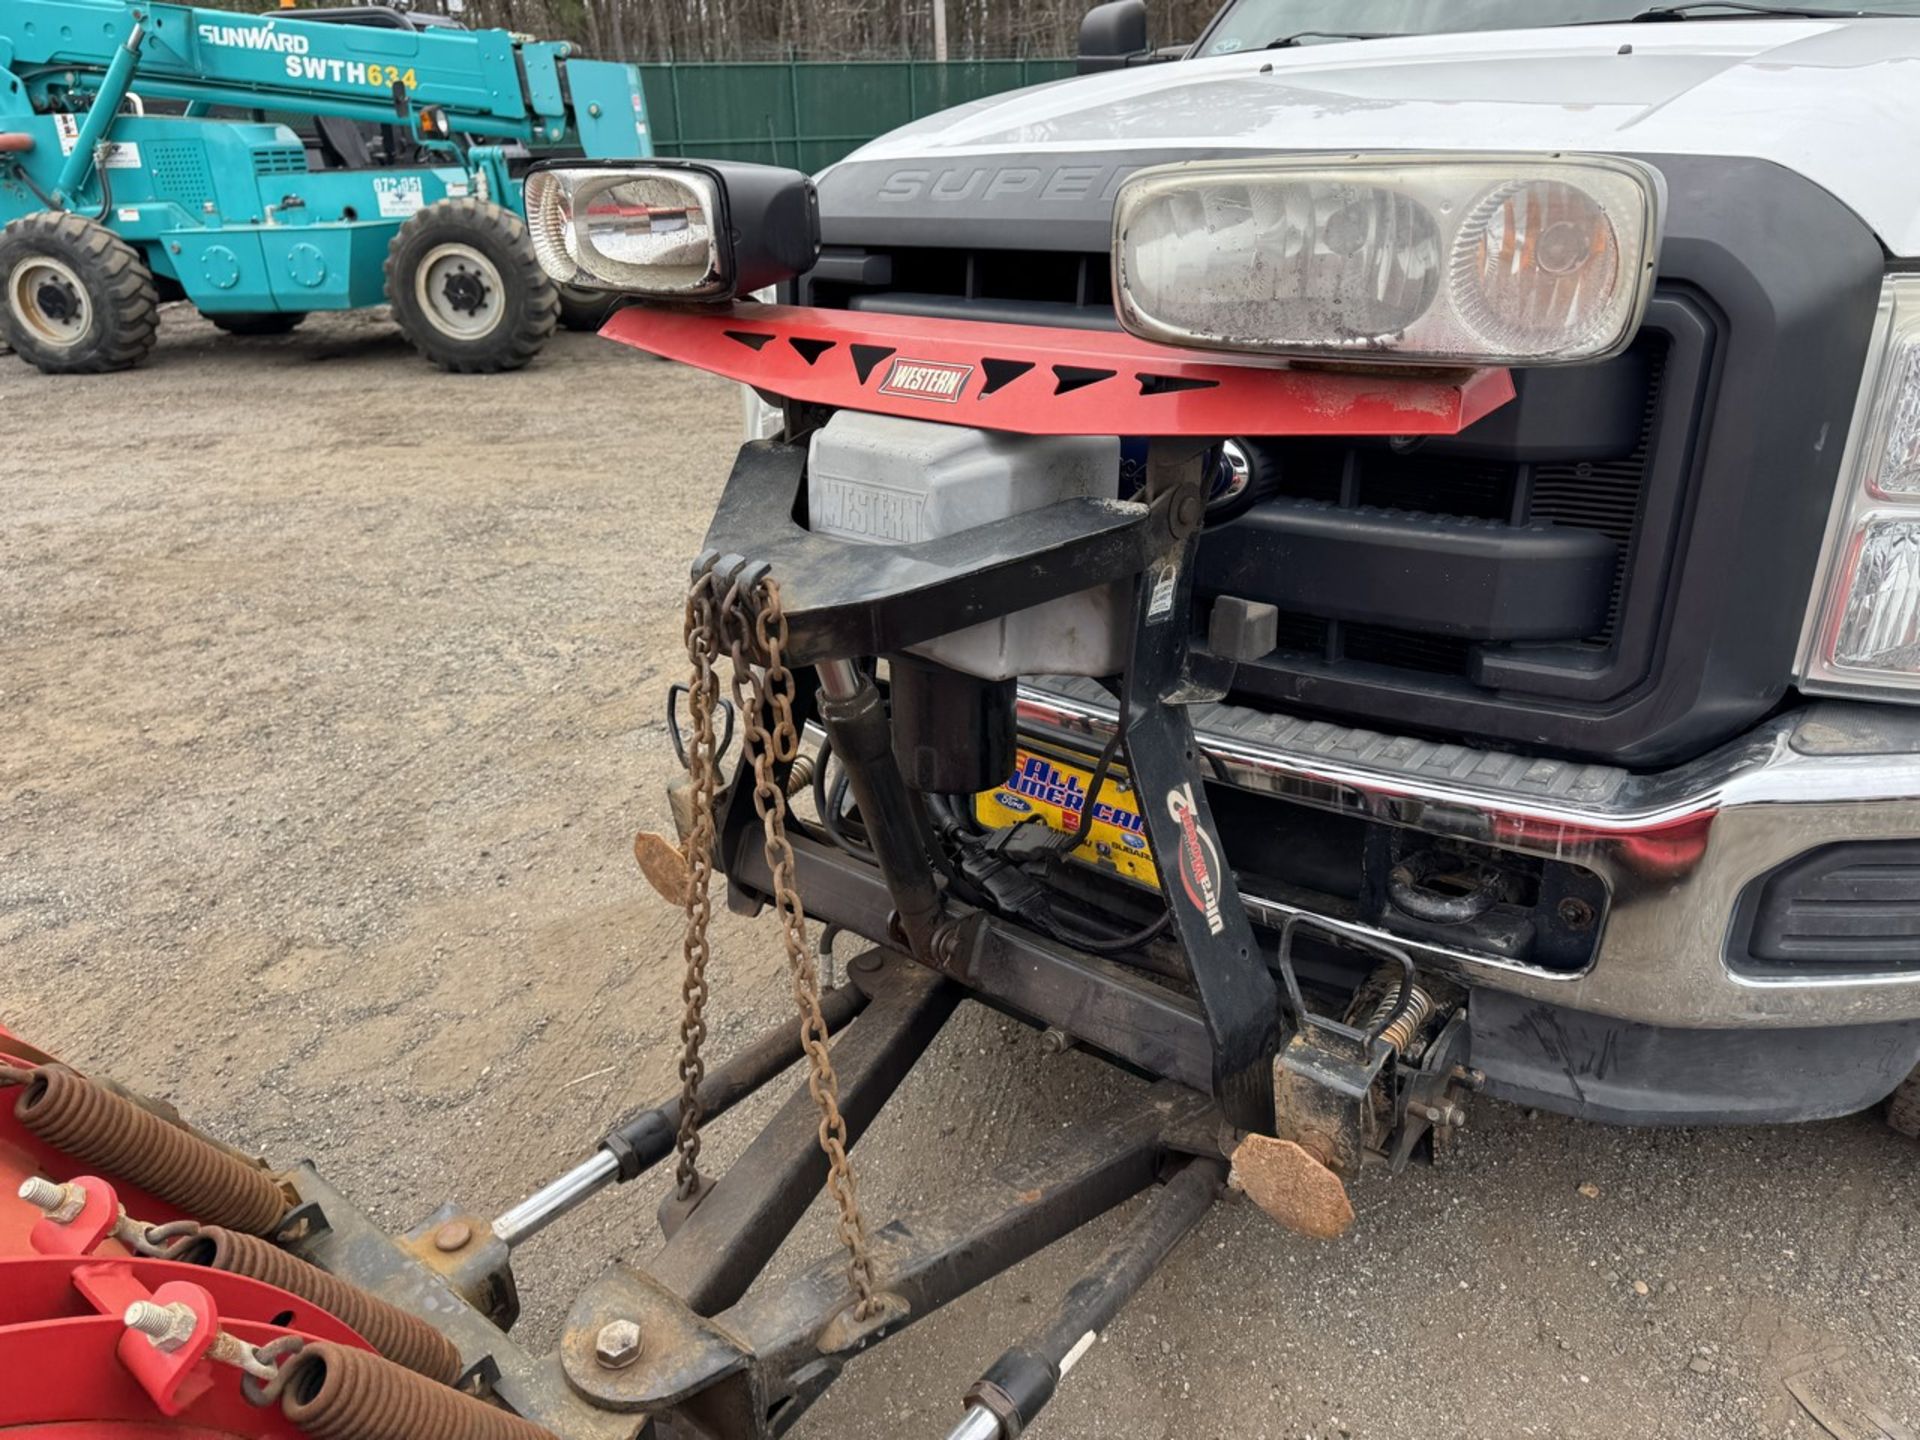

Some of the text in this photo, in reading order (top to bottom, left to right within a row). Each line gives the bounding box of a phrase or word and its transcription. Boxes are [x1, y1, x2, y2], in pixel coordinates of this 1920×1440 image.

[199, 21, 309, 55] SUNWARD
[285, 55, 418, 90] SWTH634
[891, 365, 962, 395] WESTERN
[820, 480, 922, 544] WESTERN
[1024, 757, 1084, 794] ALL
[1001, 794, 1026, 811] Ford
[1166, 782, 1198, 824] 2
[1111, 841, 1153, 861] SUBAR
